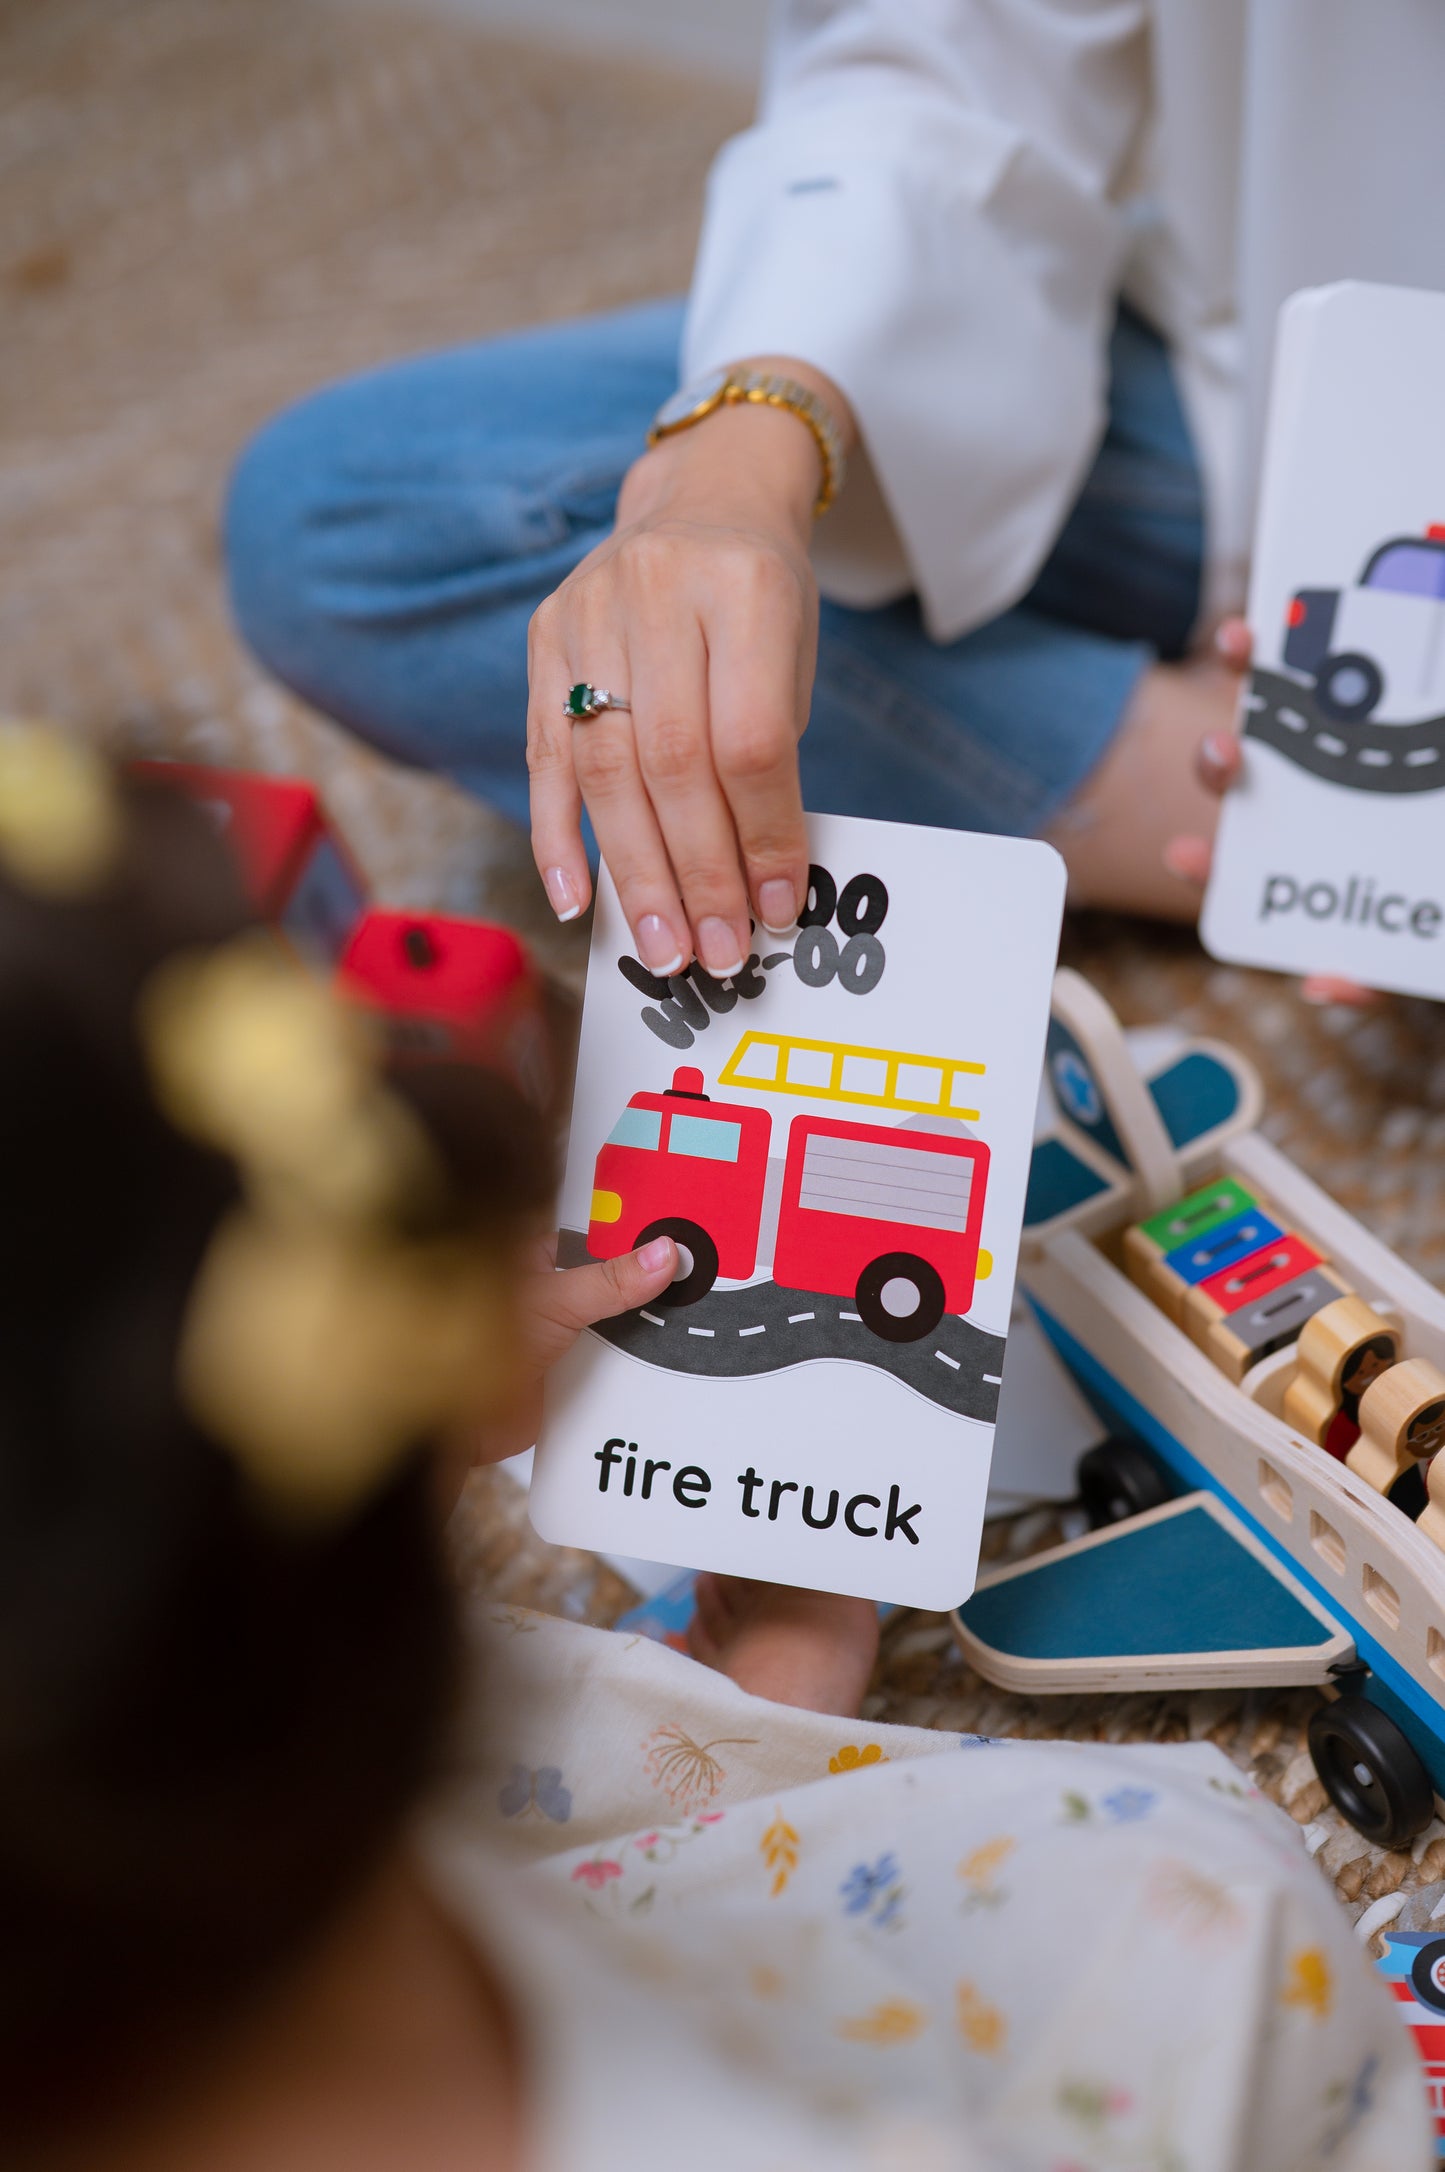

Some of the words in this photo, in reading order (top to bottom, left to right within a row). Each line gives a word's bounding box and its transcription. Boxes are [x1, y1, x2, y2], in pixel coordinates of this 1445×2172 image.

[1261, 875, 1443, 939] police
[594, 1438, 712, 1509] fire
[737, 1466, 923, 1546] truck
